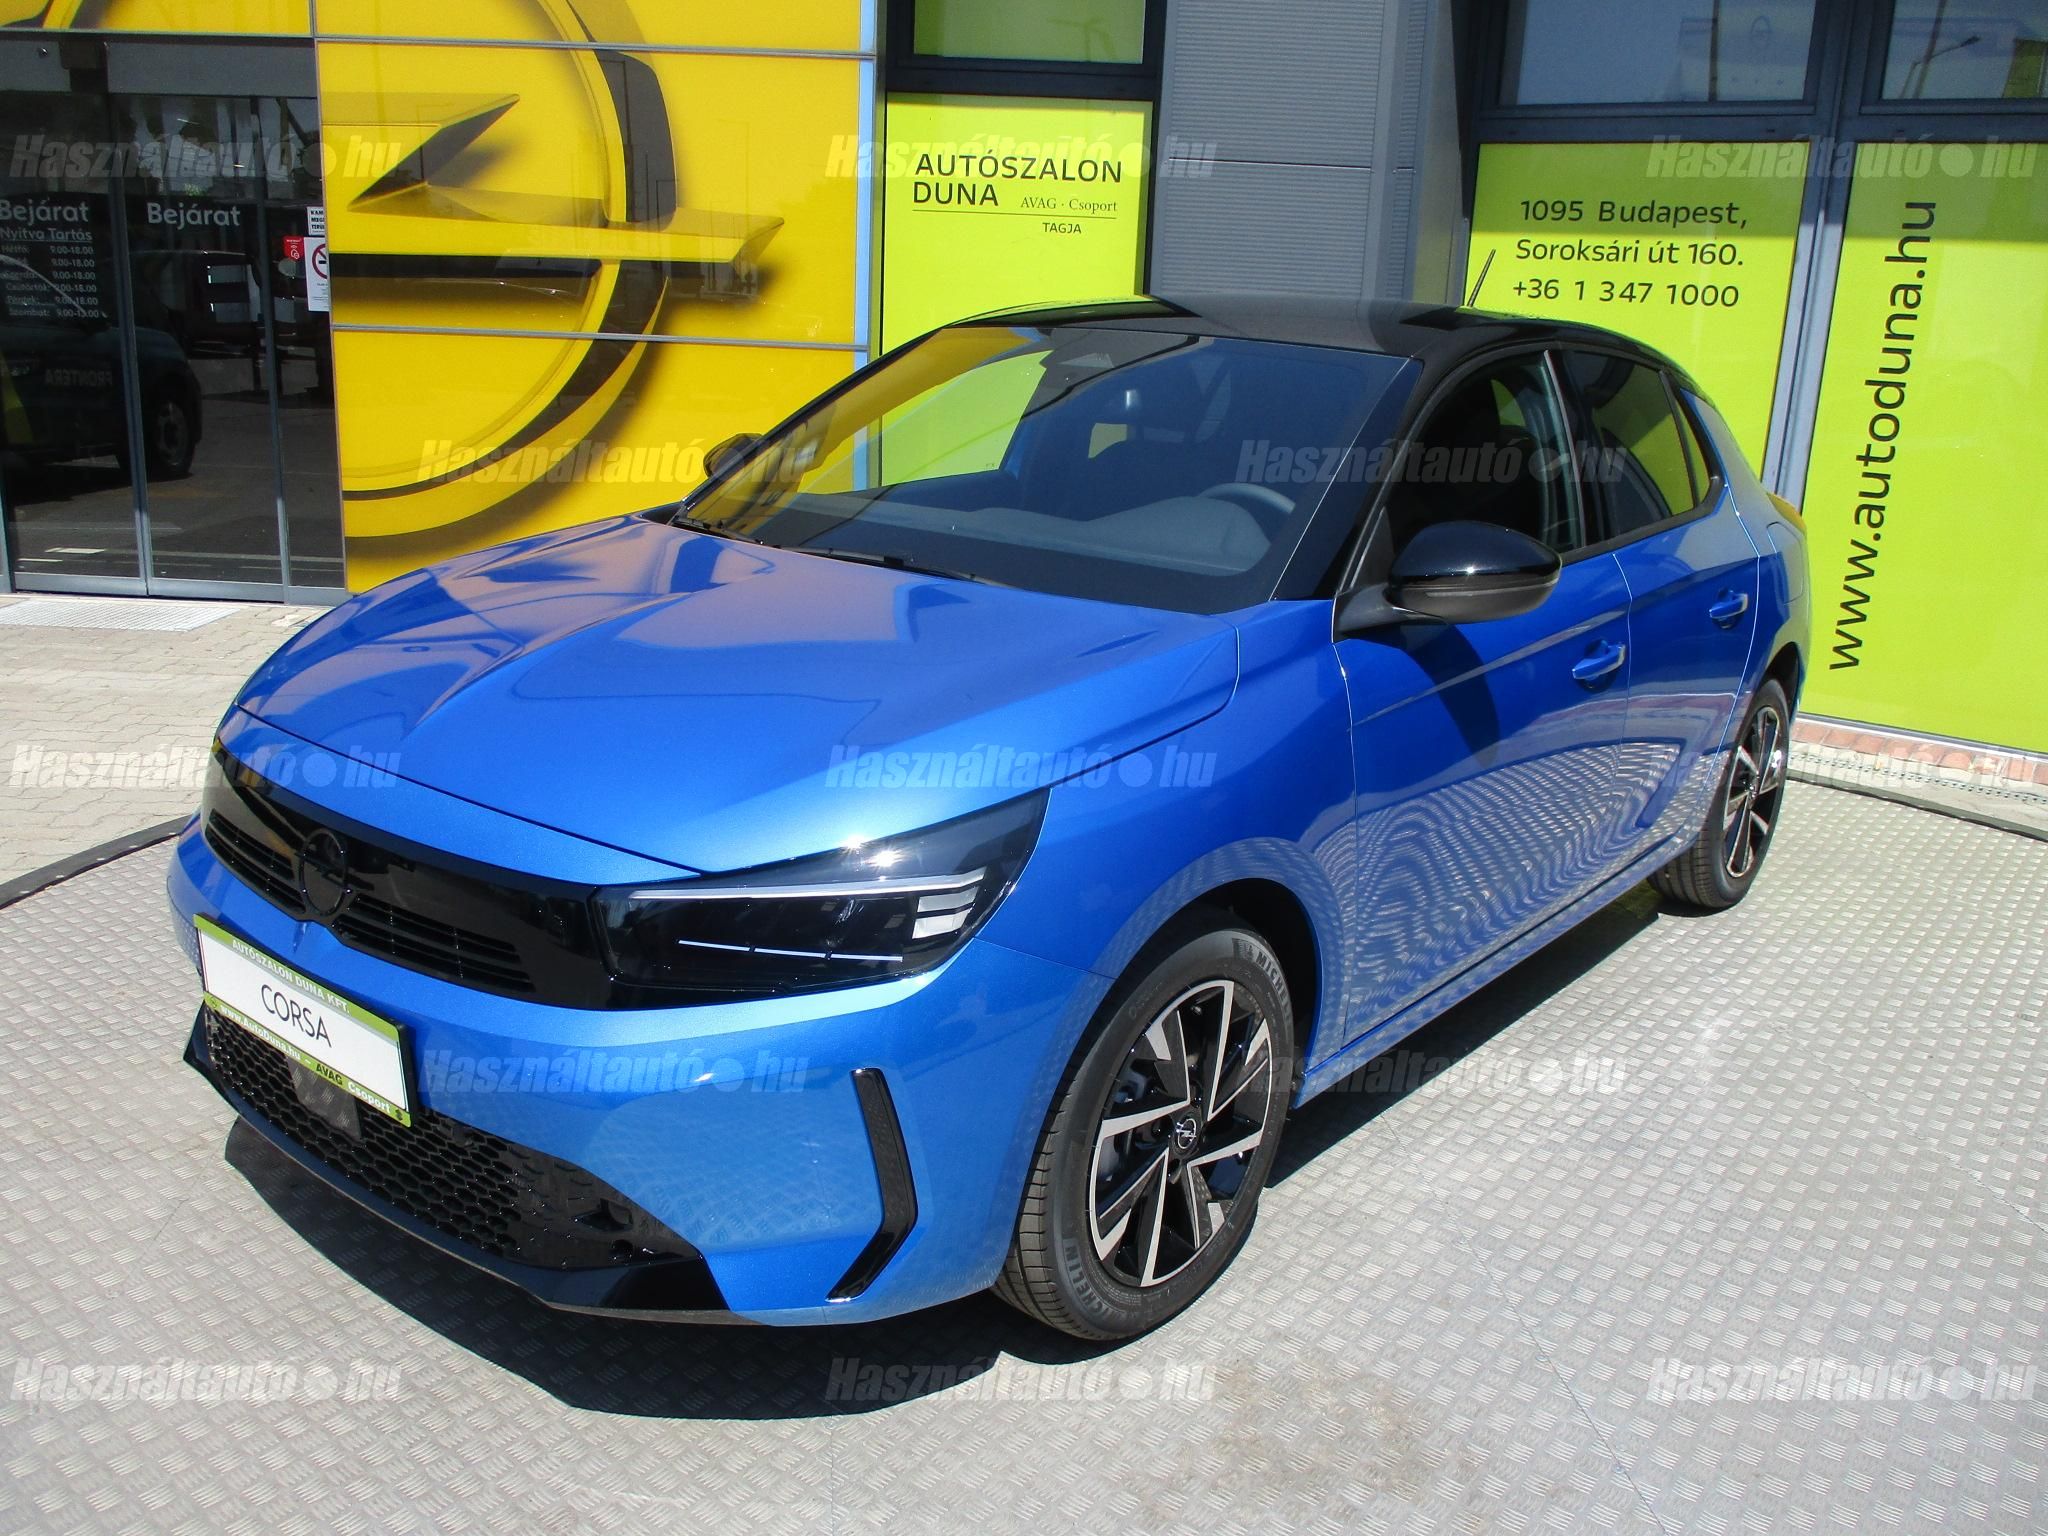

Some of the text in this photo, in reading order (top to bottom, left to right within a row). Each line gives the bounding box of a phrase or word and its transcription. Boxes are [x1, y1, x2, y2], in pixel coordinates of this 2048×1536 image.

[914, 149, 1123, 183] AUTÓSZALON
[913, 181, 1118, 214] DUNA AVAG Csoport
[0, 199, 89, 226] Bejárat
[146, 202, 241, 230] Bejárat
[1520, 200, 1748, 229] 1095 Budapest,
[0, 227, 94, 241] Nyitva Tartás
[1042, 222, 1082, 234] TAGJA
[1515, 239, 1744, 266] Soroksári út 160.
[1512, 278, 1560, 300] +36
[1574, 280, 1586, 301] 1
[1666, 284, 1740, 307] 1000
[1829, 201, 1937, 671] www.autoduna.hu
[232, 939, 350, 1013] AUTÓSZALON DUNA KFT.
[260, 983, 332, 1048] CORSA
[315, 1062, 343, 1085] AVAG
[347, 1079, 392, 1115] Csoport
